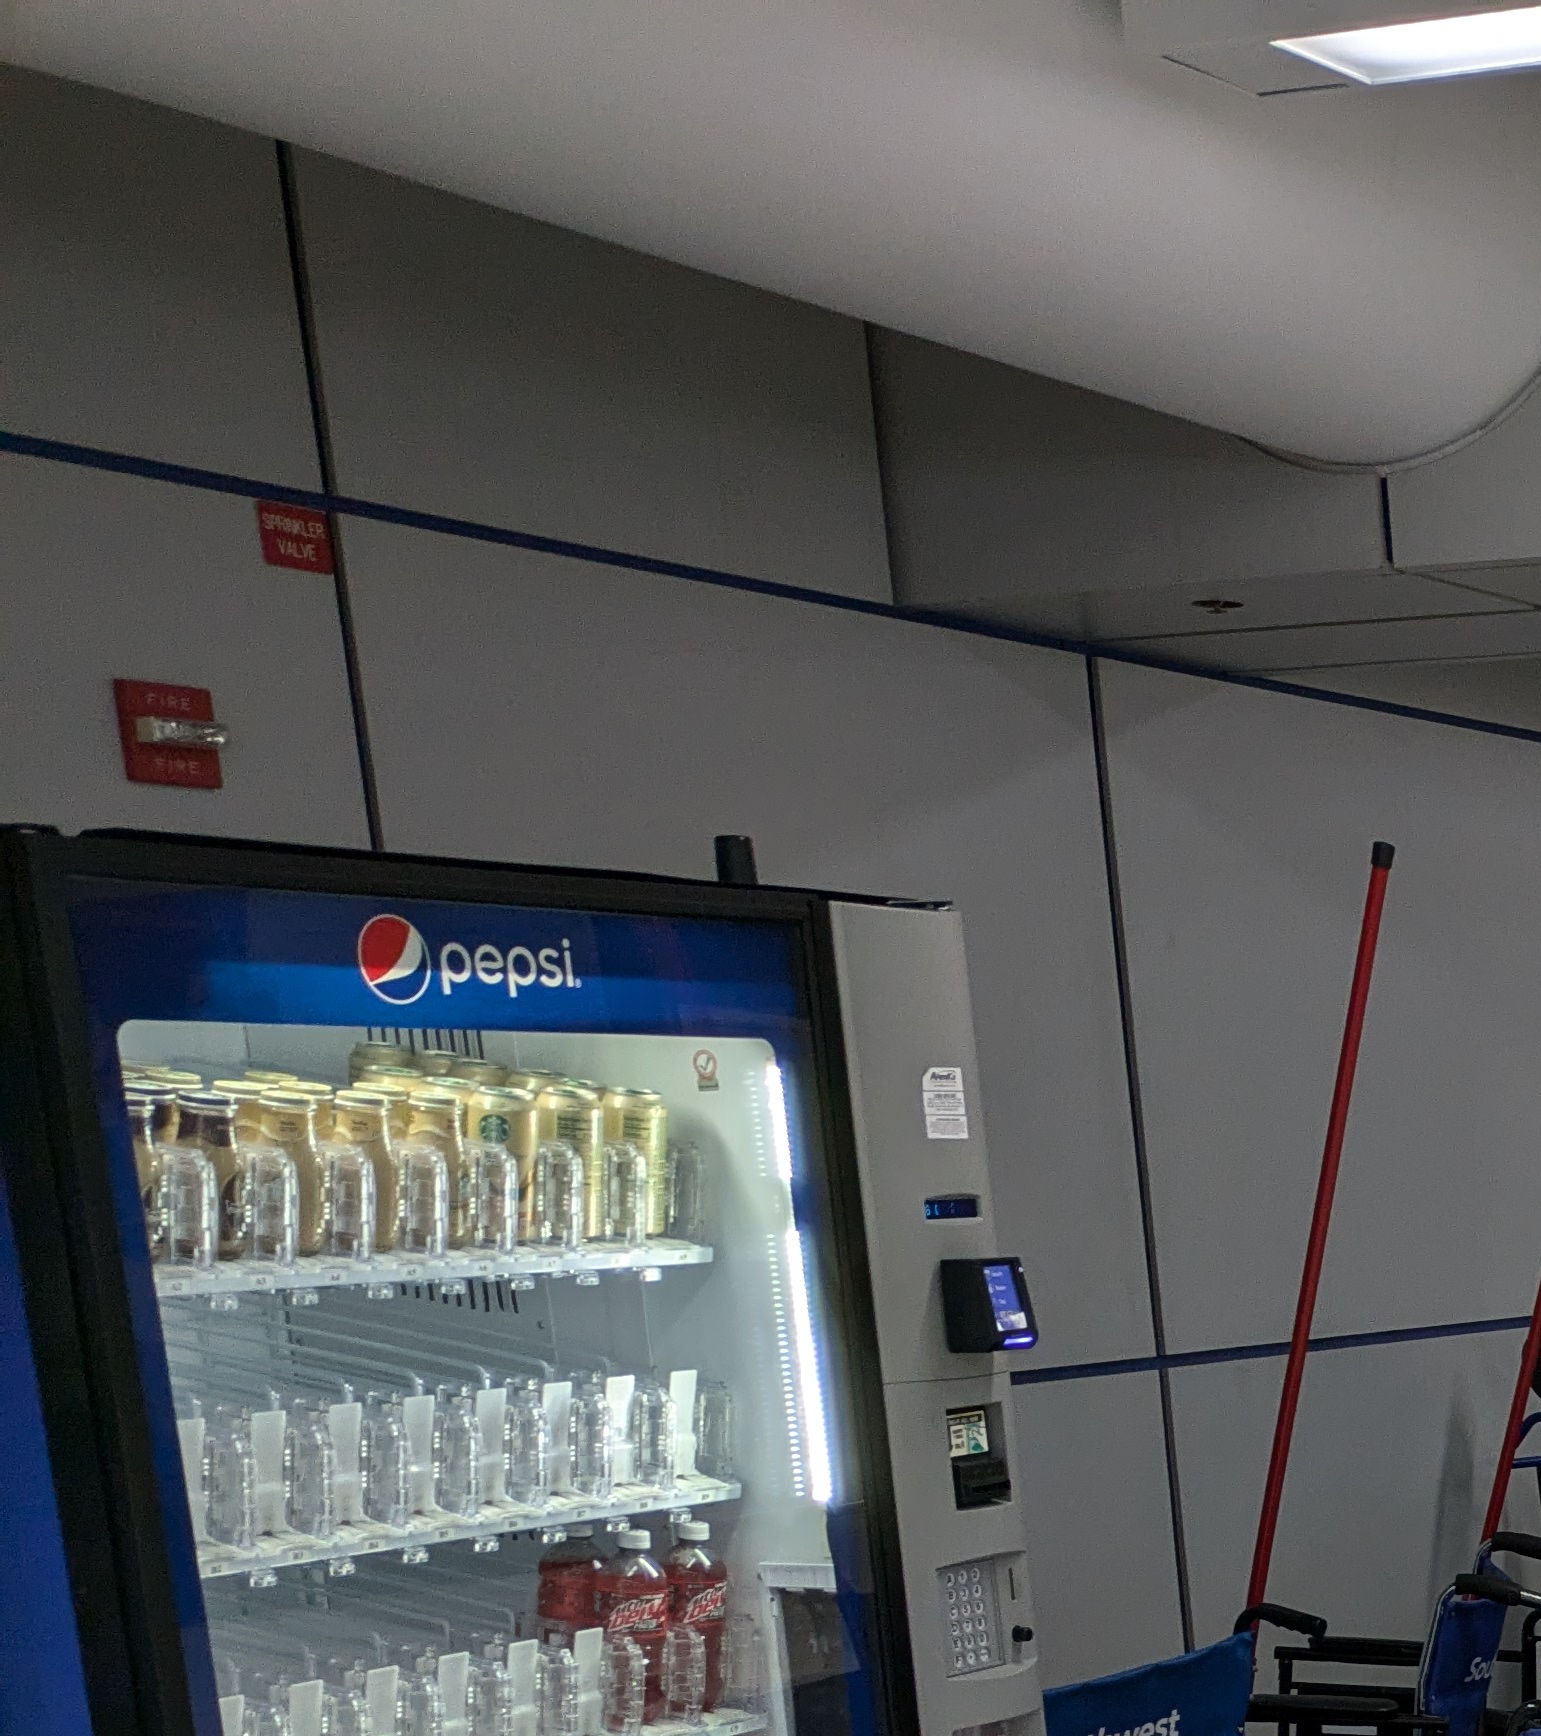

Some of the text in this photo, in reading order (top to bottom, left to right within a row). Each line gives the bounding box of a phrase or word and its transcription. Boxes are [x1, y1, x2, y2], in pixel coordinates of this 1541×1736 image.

[262, 513, 324, 539] SPRINKLER
[276, 539, 316, 562] VALVE
[146, 695, 191, 711] FIRE
[154, 758, 199, 775] FIRE
